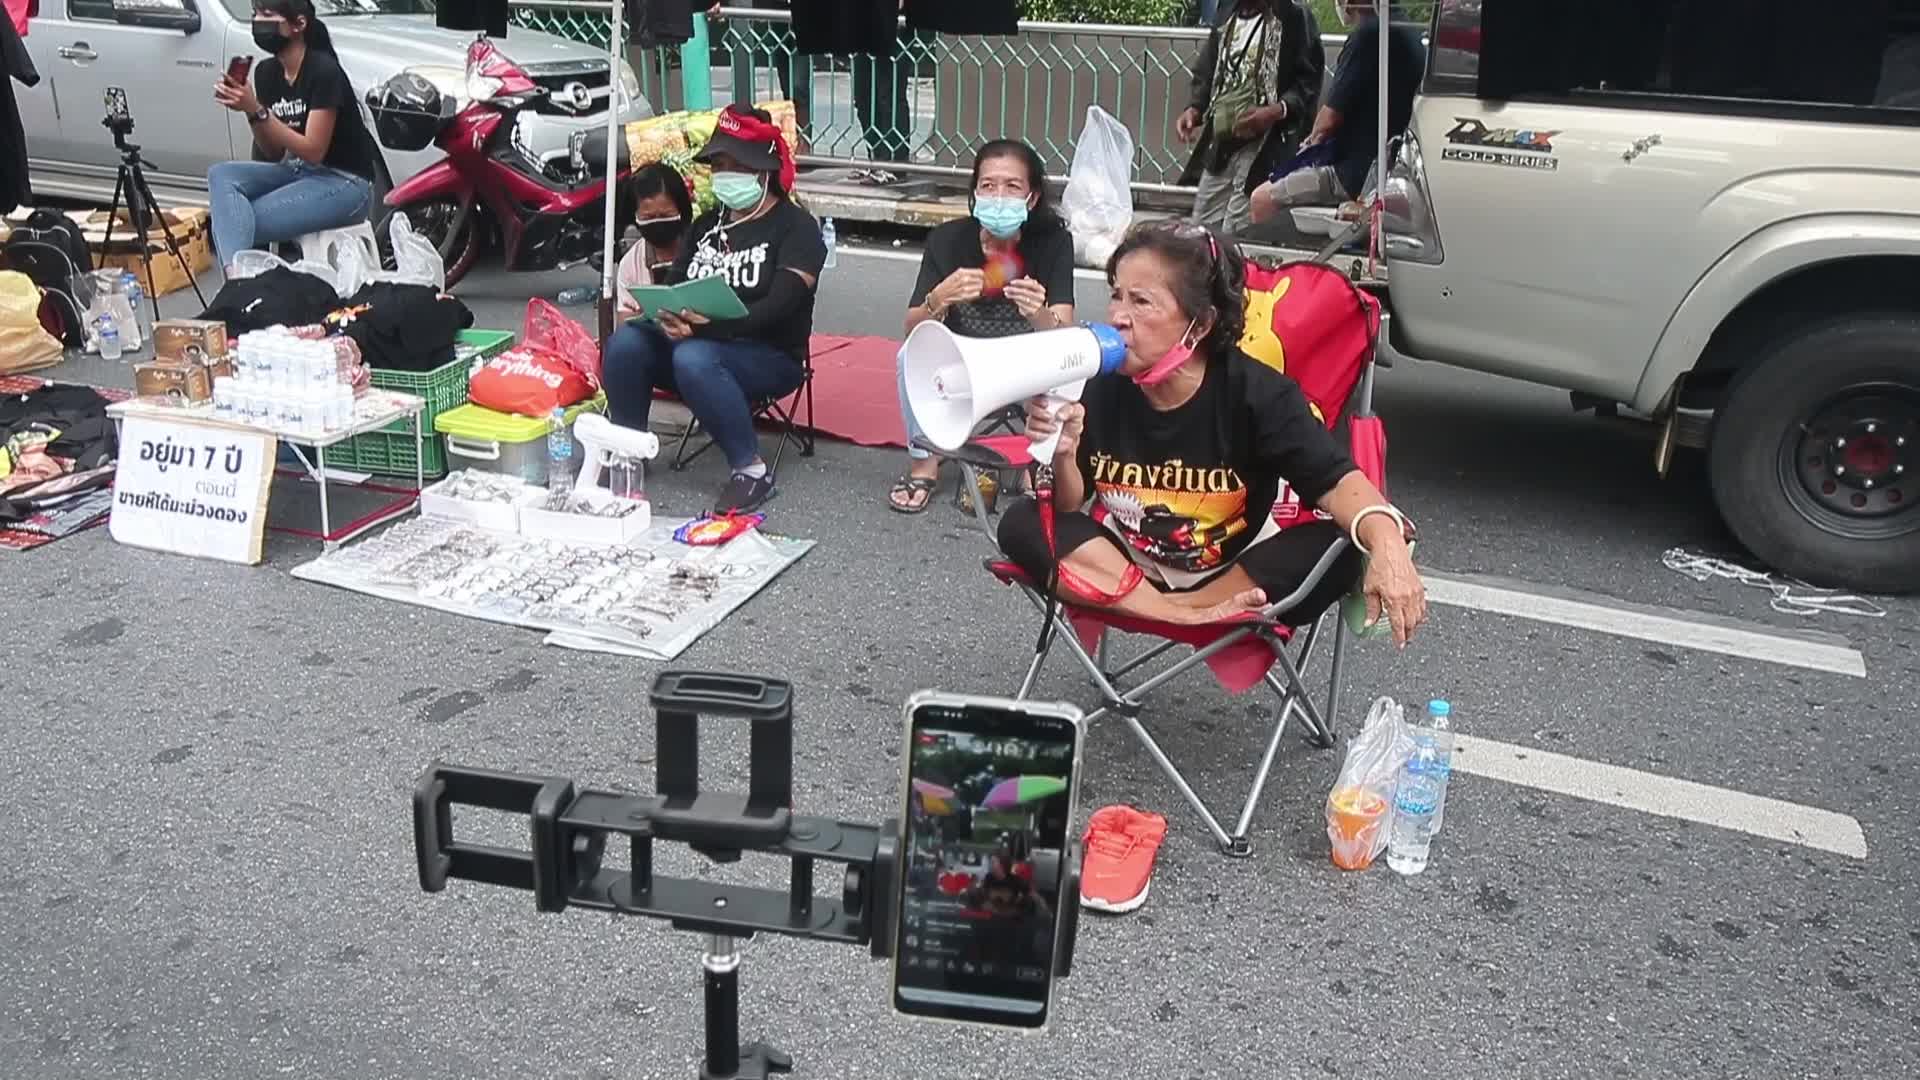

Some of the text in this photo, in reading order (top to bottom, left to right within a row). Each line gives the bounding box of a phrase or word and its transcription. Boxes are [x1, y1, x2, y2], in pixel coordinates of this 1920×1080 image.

[1444, 149, 1555, 169] GOLD SERIES
[139, 435, 243, 474] อยู่มา 7 ปี
